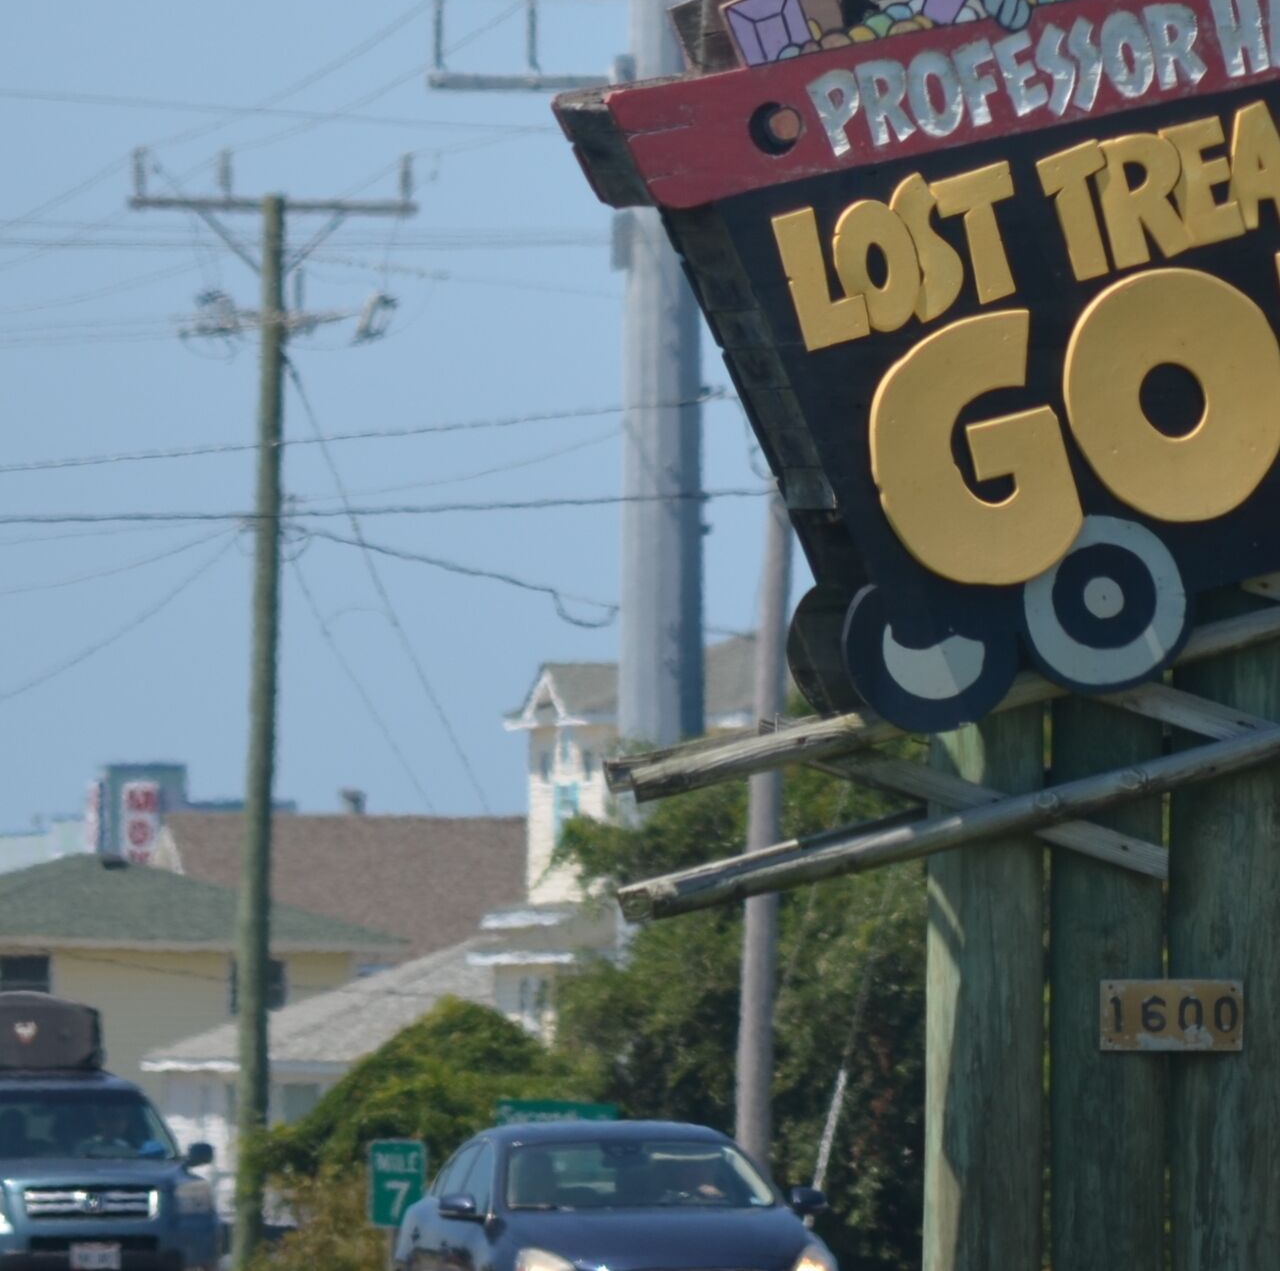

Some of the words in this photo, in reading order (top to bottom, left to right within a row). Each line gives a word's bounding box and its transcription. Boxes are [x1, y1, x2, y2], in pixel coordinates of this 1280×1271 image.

[807, 4, 1207, 157] PROFESSOR
[772, 160, 1016, 351] LOST
[1110, 995, 1239, 1033] 1600
[375, 1151, 419, 1173] MILE
[384, 1180, 411, 1220] 7
